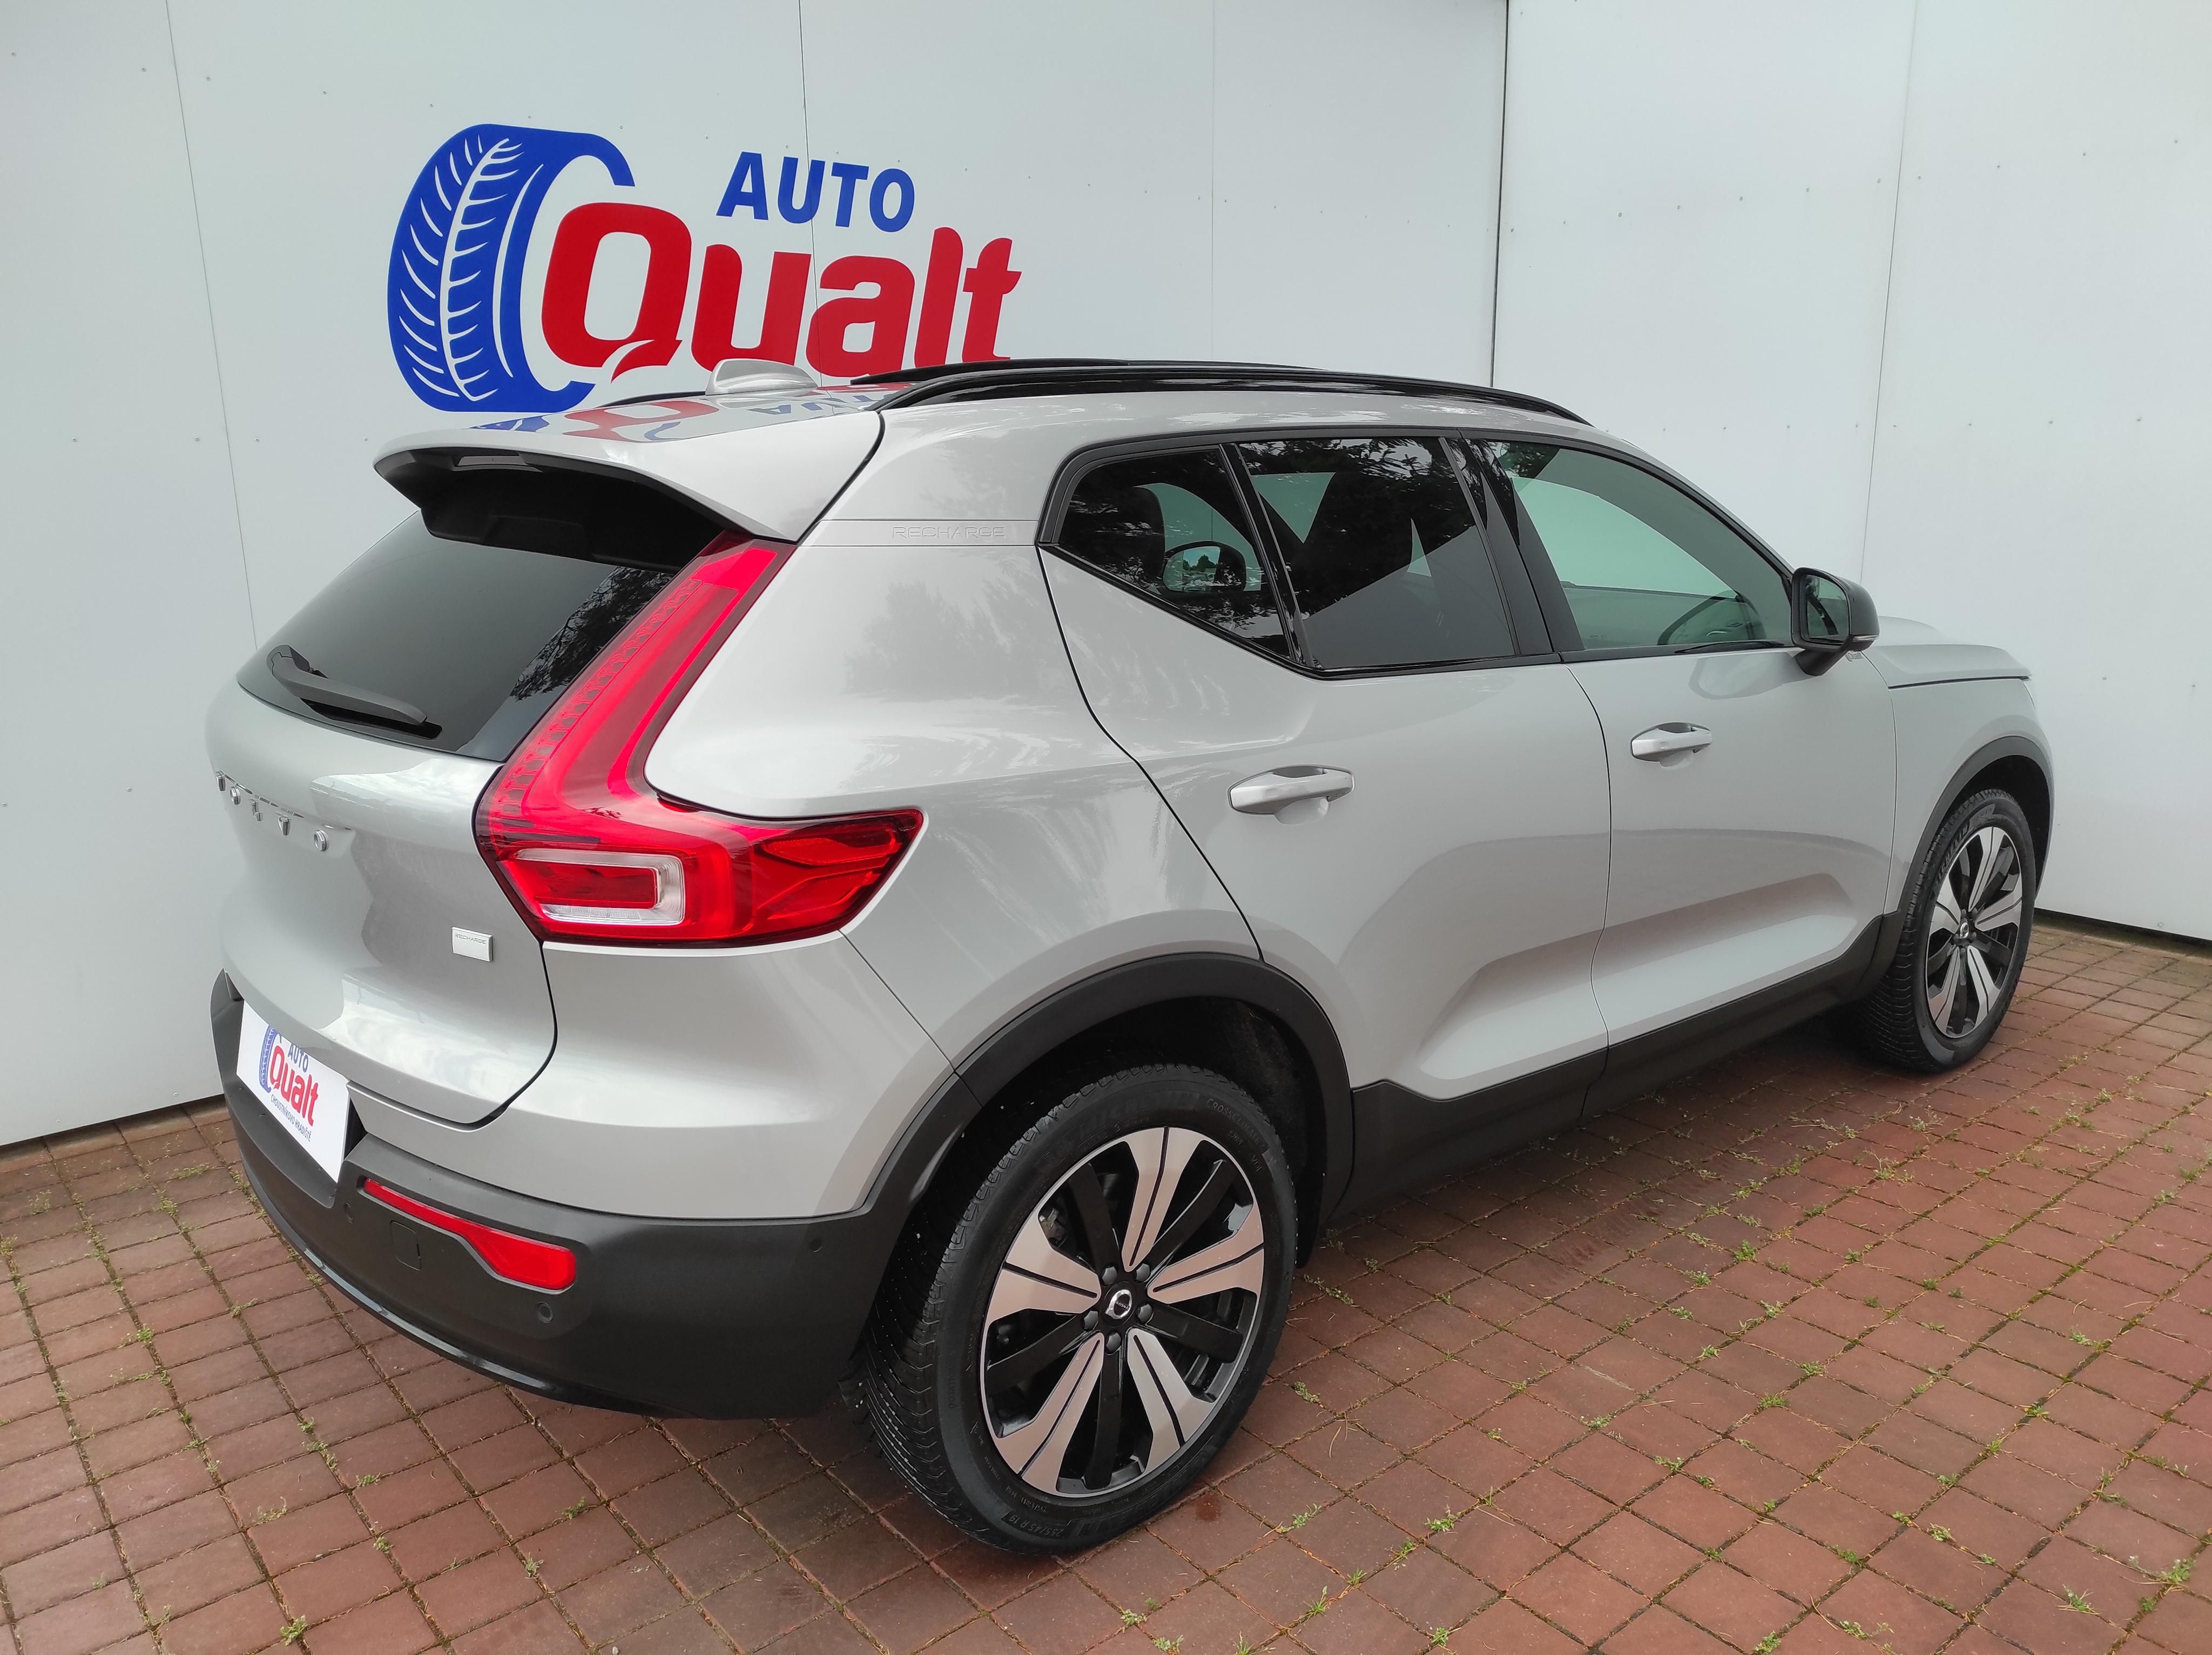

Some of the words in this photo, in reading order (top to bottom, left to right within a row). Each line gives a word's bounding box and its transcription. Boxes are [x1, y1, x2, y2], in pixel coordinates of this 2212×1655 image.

[716, 152, 915, 233] AUTO
[542, 202, 1022, 383] Qualt
[892, 526, 1006, 539] RECHARGE
[455, 933, 487, 945] RECHARGE
[288, 1043, 308, 1072] AUTO
[270, 1045, 318, 1126] Qualt
[271, 1094, 295, 1124] CHOUSTNÍKOVO
